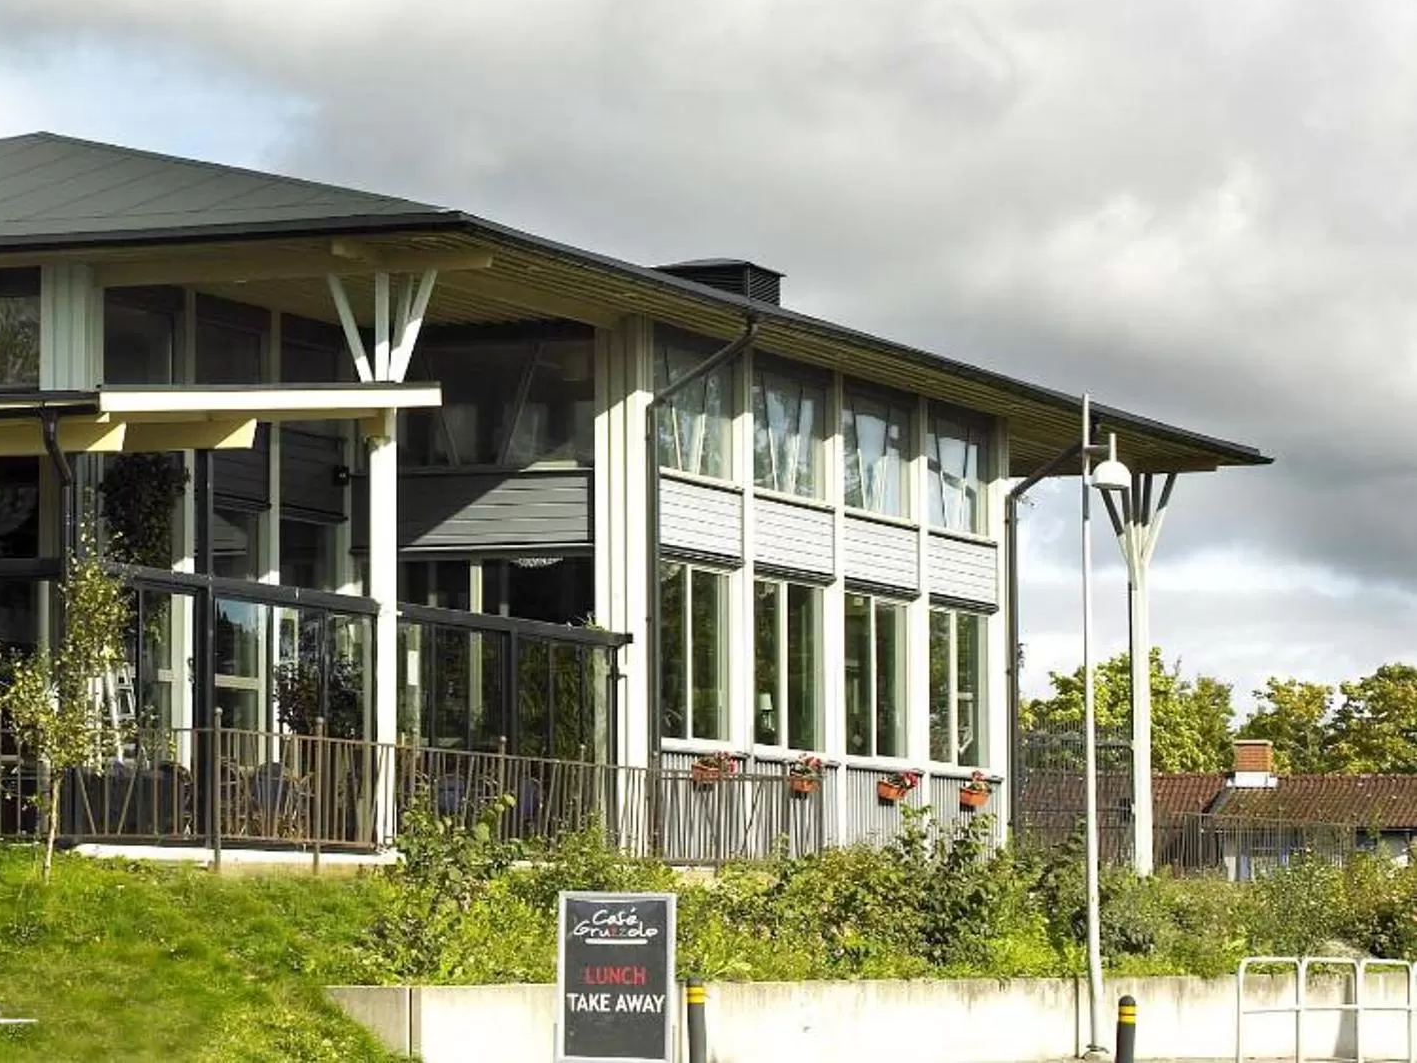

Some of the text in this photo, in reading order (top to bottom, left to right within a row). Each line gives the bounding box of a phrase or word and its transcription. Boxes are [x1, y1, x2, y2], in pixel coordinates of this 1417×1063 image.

[592, 907, 638, 926] Café
[585, 967, 647, 985] LUNCH
[566, 993, 665, 1013] TAKE AWAY
